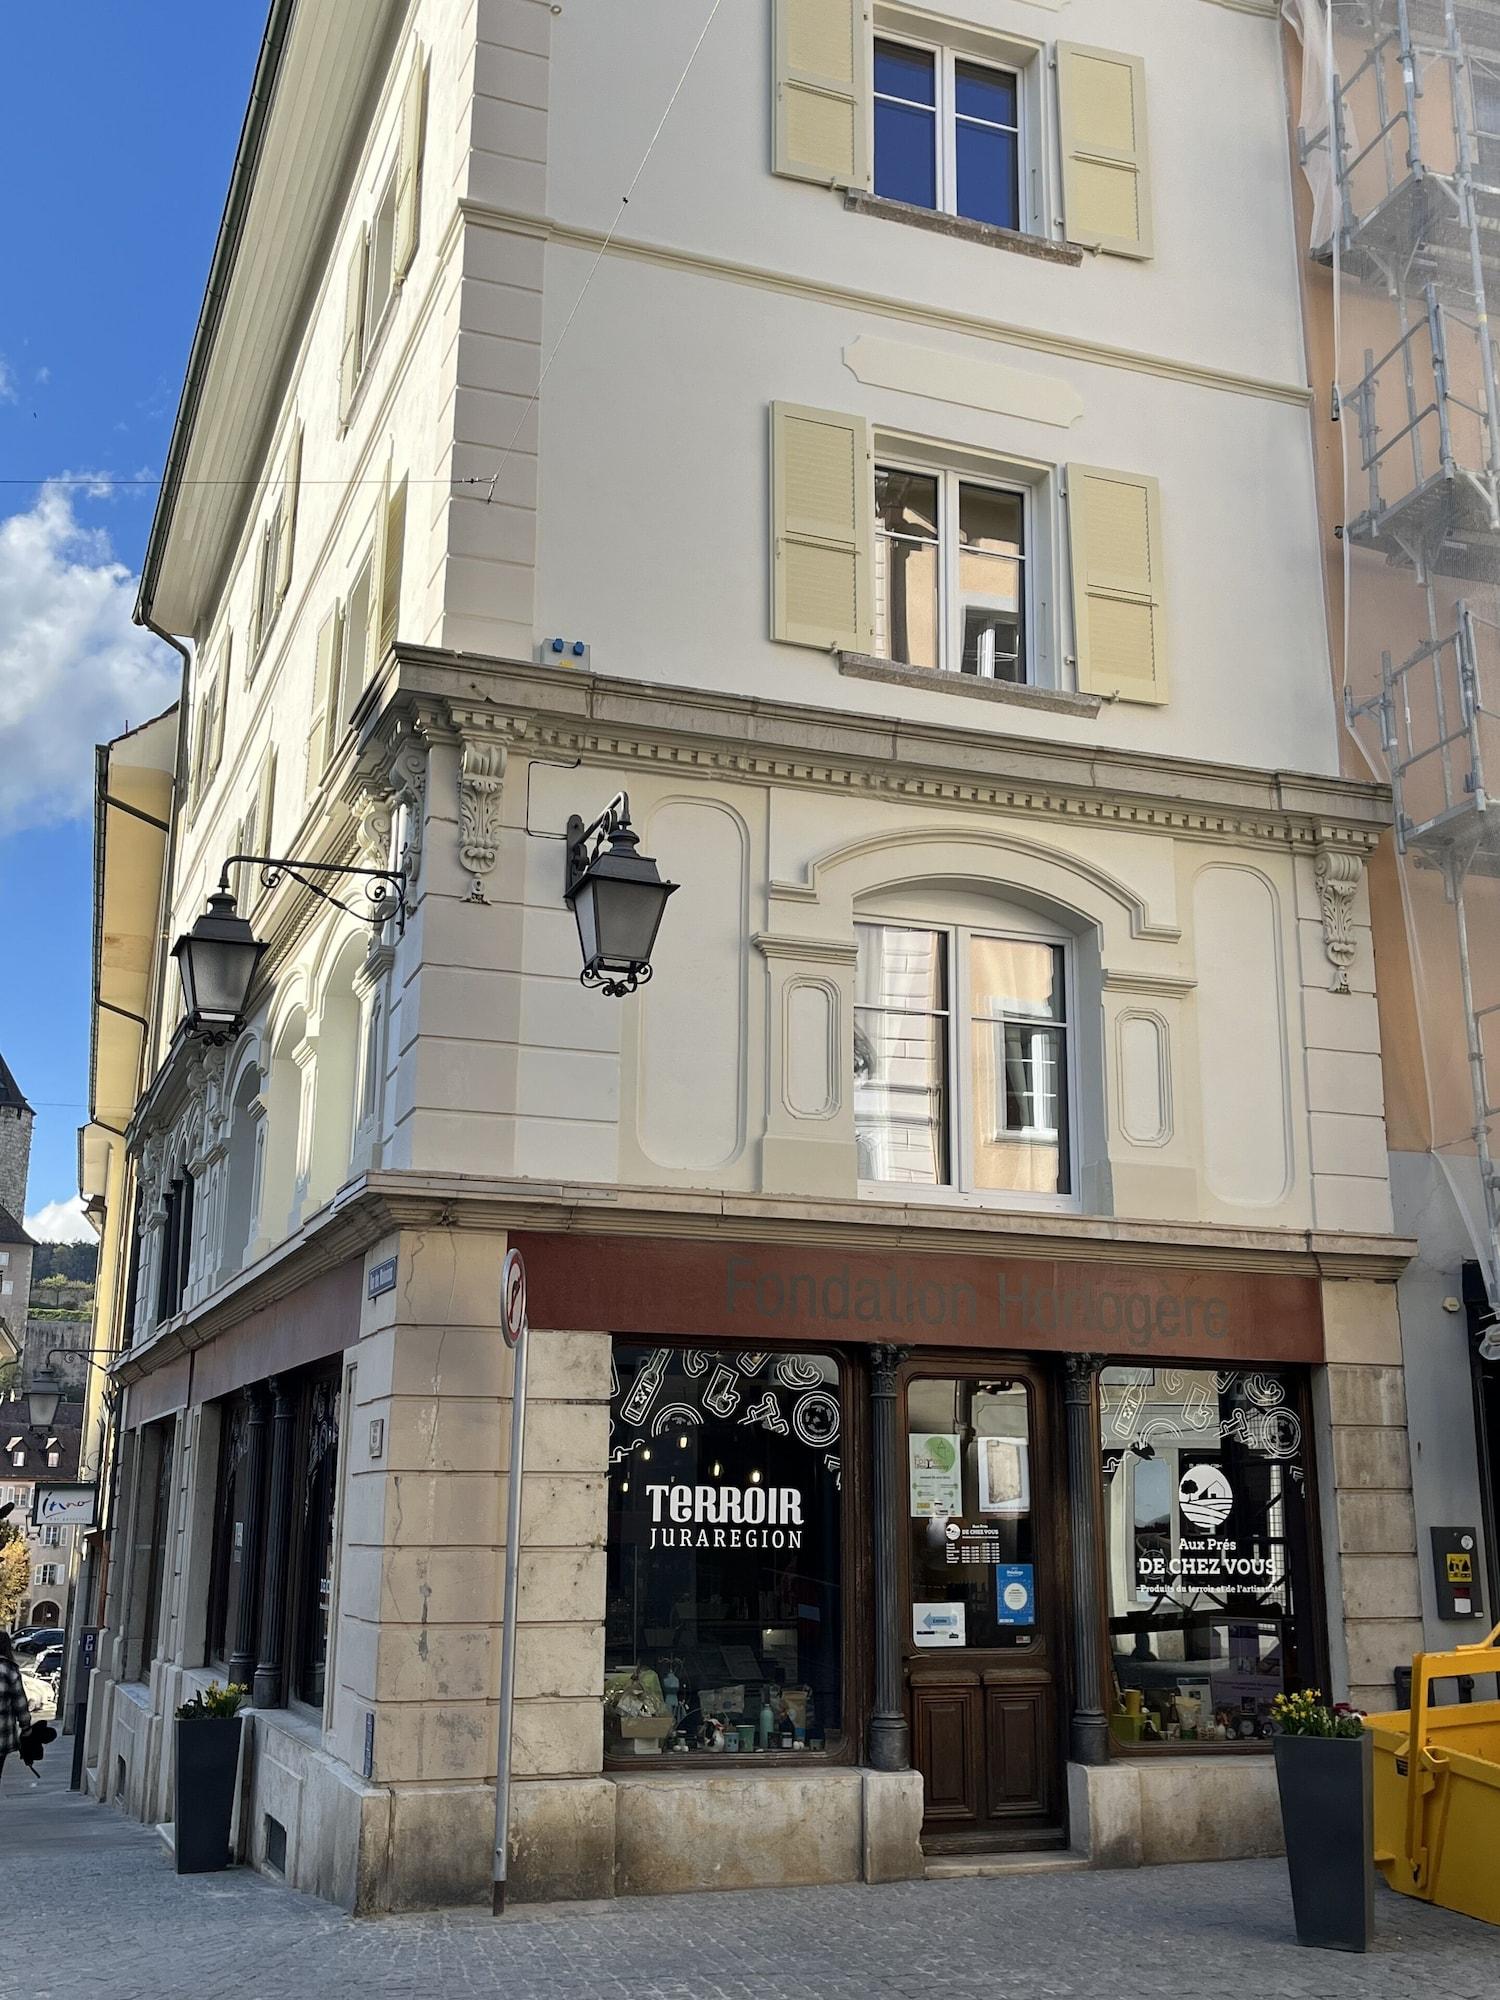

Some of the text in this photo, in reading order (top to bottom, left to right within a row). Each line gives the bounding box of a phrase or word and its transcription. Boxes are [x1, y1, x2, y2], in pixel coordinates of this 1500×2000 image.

[726, 1256, 976, 1325] Fondation
[650, 1528, 802, 1550] JURAREGION
[1179, 1538, 1237, 1550] Aux Prés
[1138, 1557, 1277, 1575] DE CHEZ VOUS
[1176, 1584, 1187, 1593] du
